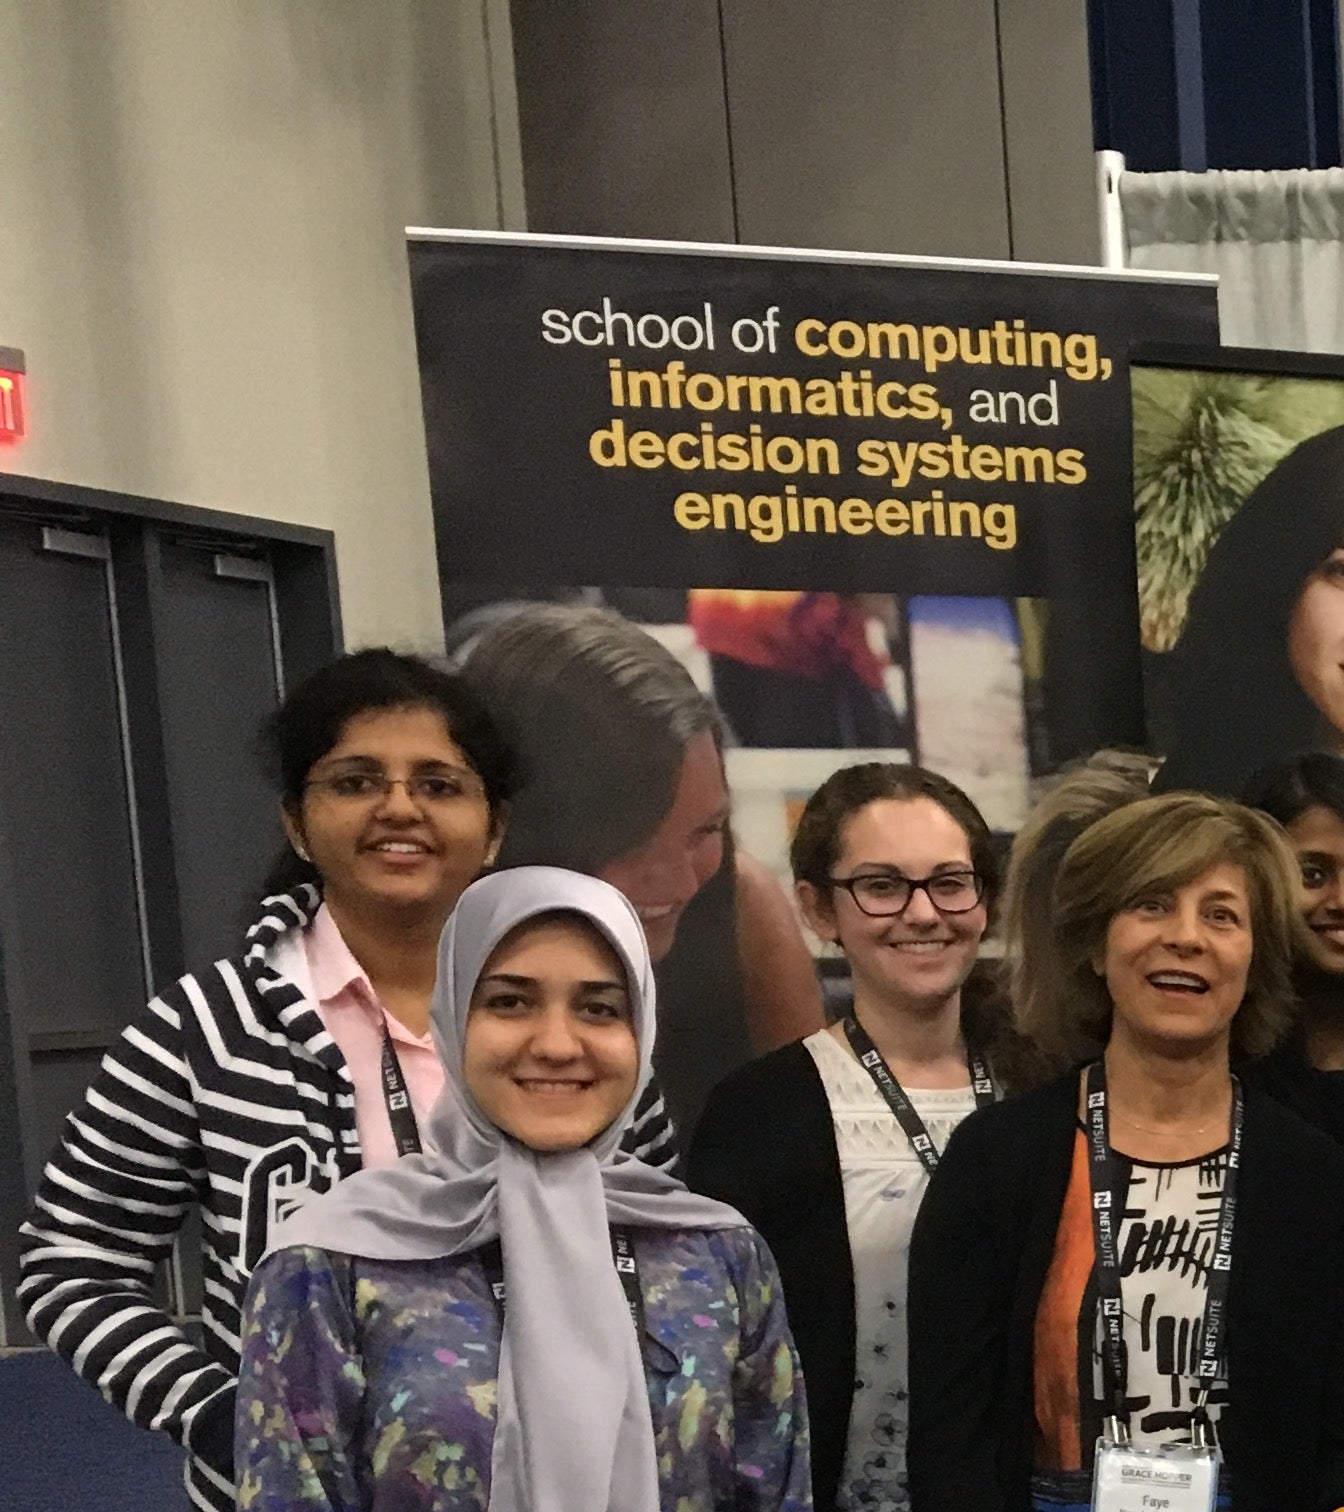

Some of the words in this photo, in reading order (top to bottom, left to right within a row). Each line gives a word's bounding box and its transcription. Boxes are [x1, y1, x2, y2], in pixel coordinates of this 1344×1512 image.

[541, 297, 714, 352] school
[731, 307, 779, 354] of
[795, 317, 1113, 381] computing,
[608, 358, 954, 429] informatics,
[968, 381, 1059, 427] and
[589, 420, 840, 476] decision
[857, 438, 1087, 488] systems
[673, 485, 1017, 551] engineering
[1143, 1495, 1169, 1509] Faye
